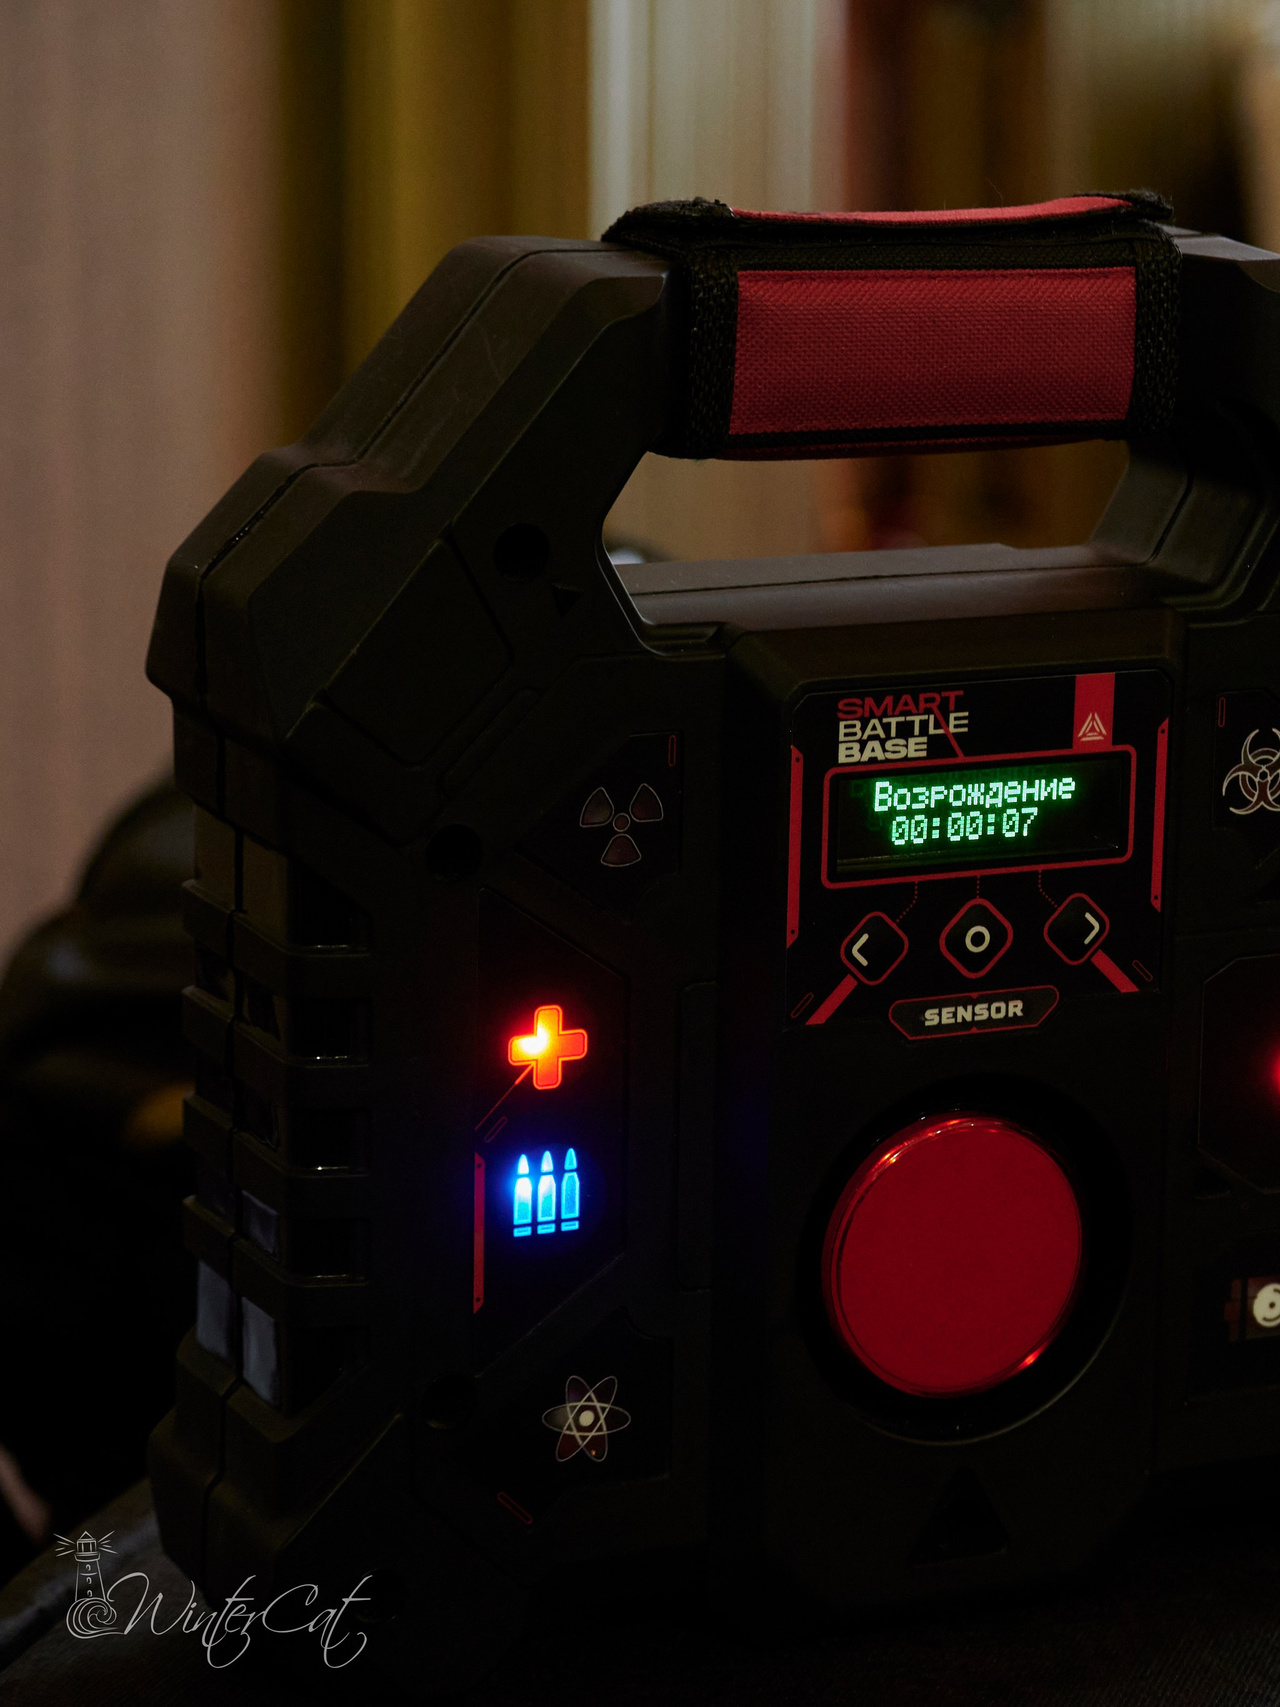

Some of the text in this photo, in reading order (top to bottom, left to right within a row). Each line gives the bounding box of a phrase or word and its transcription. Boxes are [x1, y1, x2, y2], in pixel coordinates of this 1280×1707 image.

[836, 690, 965, 719] SMART
[838, 711, 969, 743] BATTLE
[838, 736, 928, 764] BASE
[873, 777, 1076, 812] Возрождение
[891, 807, 1038, 846] 00:00:07
[924, 1000, 1024, 1027] SENSOR
